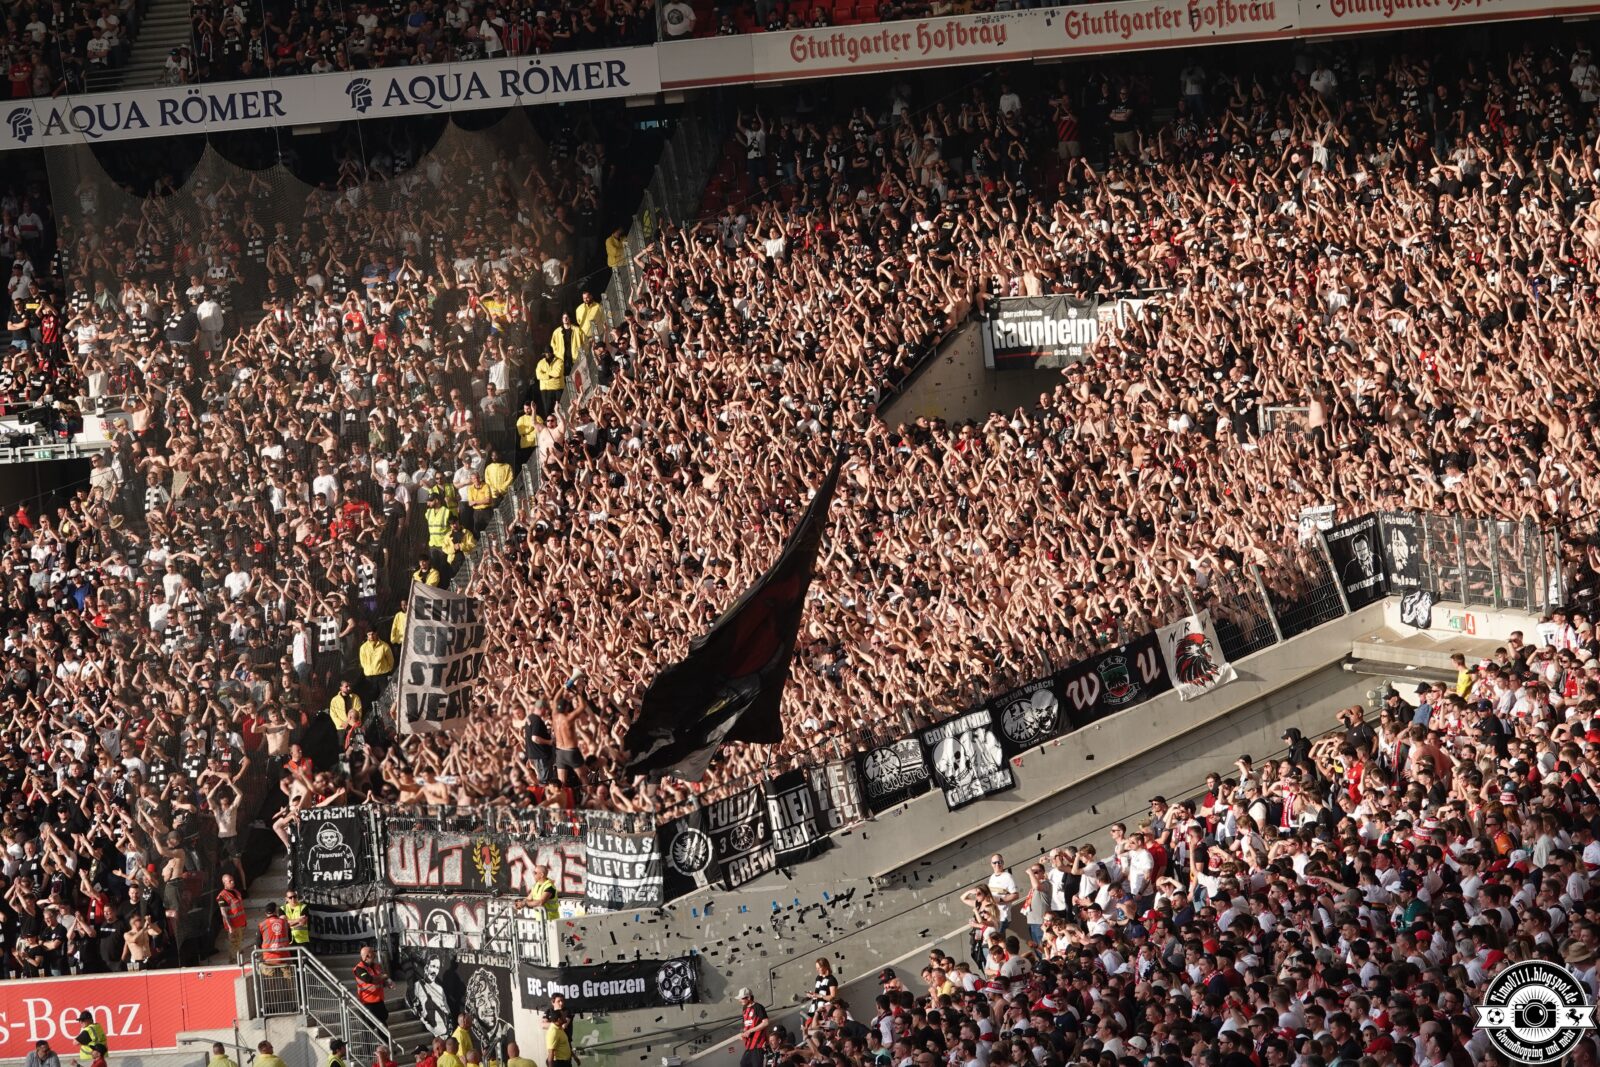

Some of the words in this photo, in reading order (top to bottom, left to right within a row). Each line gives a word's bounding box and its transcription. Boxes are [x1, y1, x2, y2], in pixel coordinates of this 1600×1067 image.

[1064, 6, 1182, 39] Stuttgarter
[790, 30, 911, 63] Stuttgarter
[382, 71, 490, 110] AQUA
[498, 59, 630, 98] RÖMER
[43, 100, 149, 138] AQUA
[157, 89, 287, 127] RÖMER
[992, 316, 1097, 349] Raunheim
[1054, 348, 1067, 356] since
[300, 805, 355, 820] EXTREME
[708, 788, 759, 830] FULDA
[768, 787, 814, 830] RIED
[587, 831, 654, 854] ULTRAS
[772, 819, 820, 851] GEBIET
[312, 869, 353, 882] FANS
[592, 857, 648, 879] NEVER
[728, 844, 777, 888] CREW
[587, 881, 659, 903] SURRENDER
[456, 951, 476, 965] FÜR
[478, 954, 511, 968] IMMER
[582, 977, 646, 998] Grenzen
